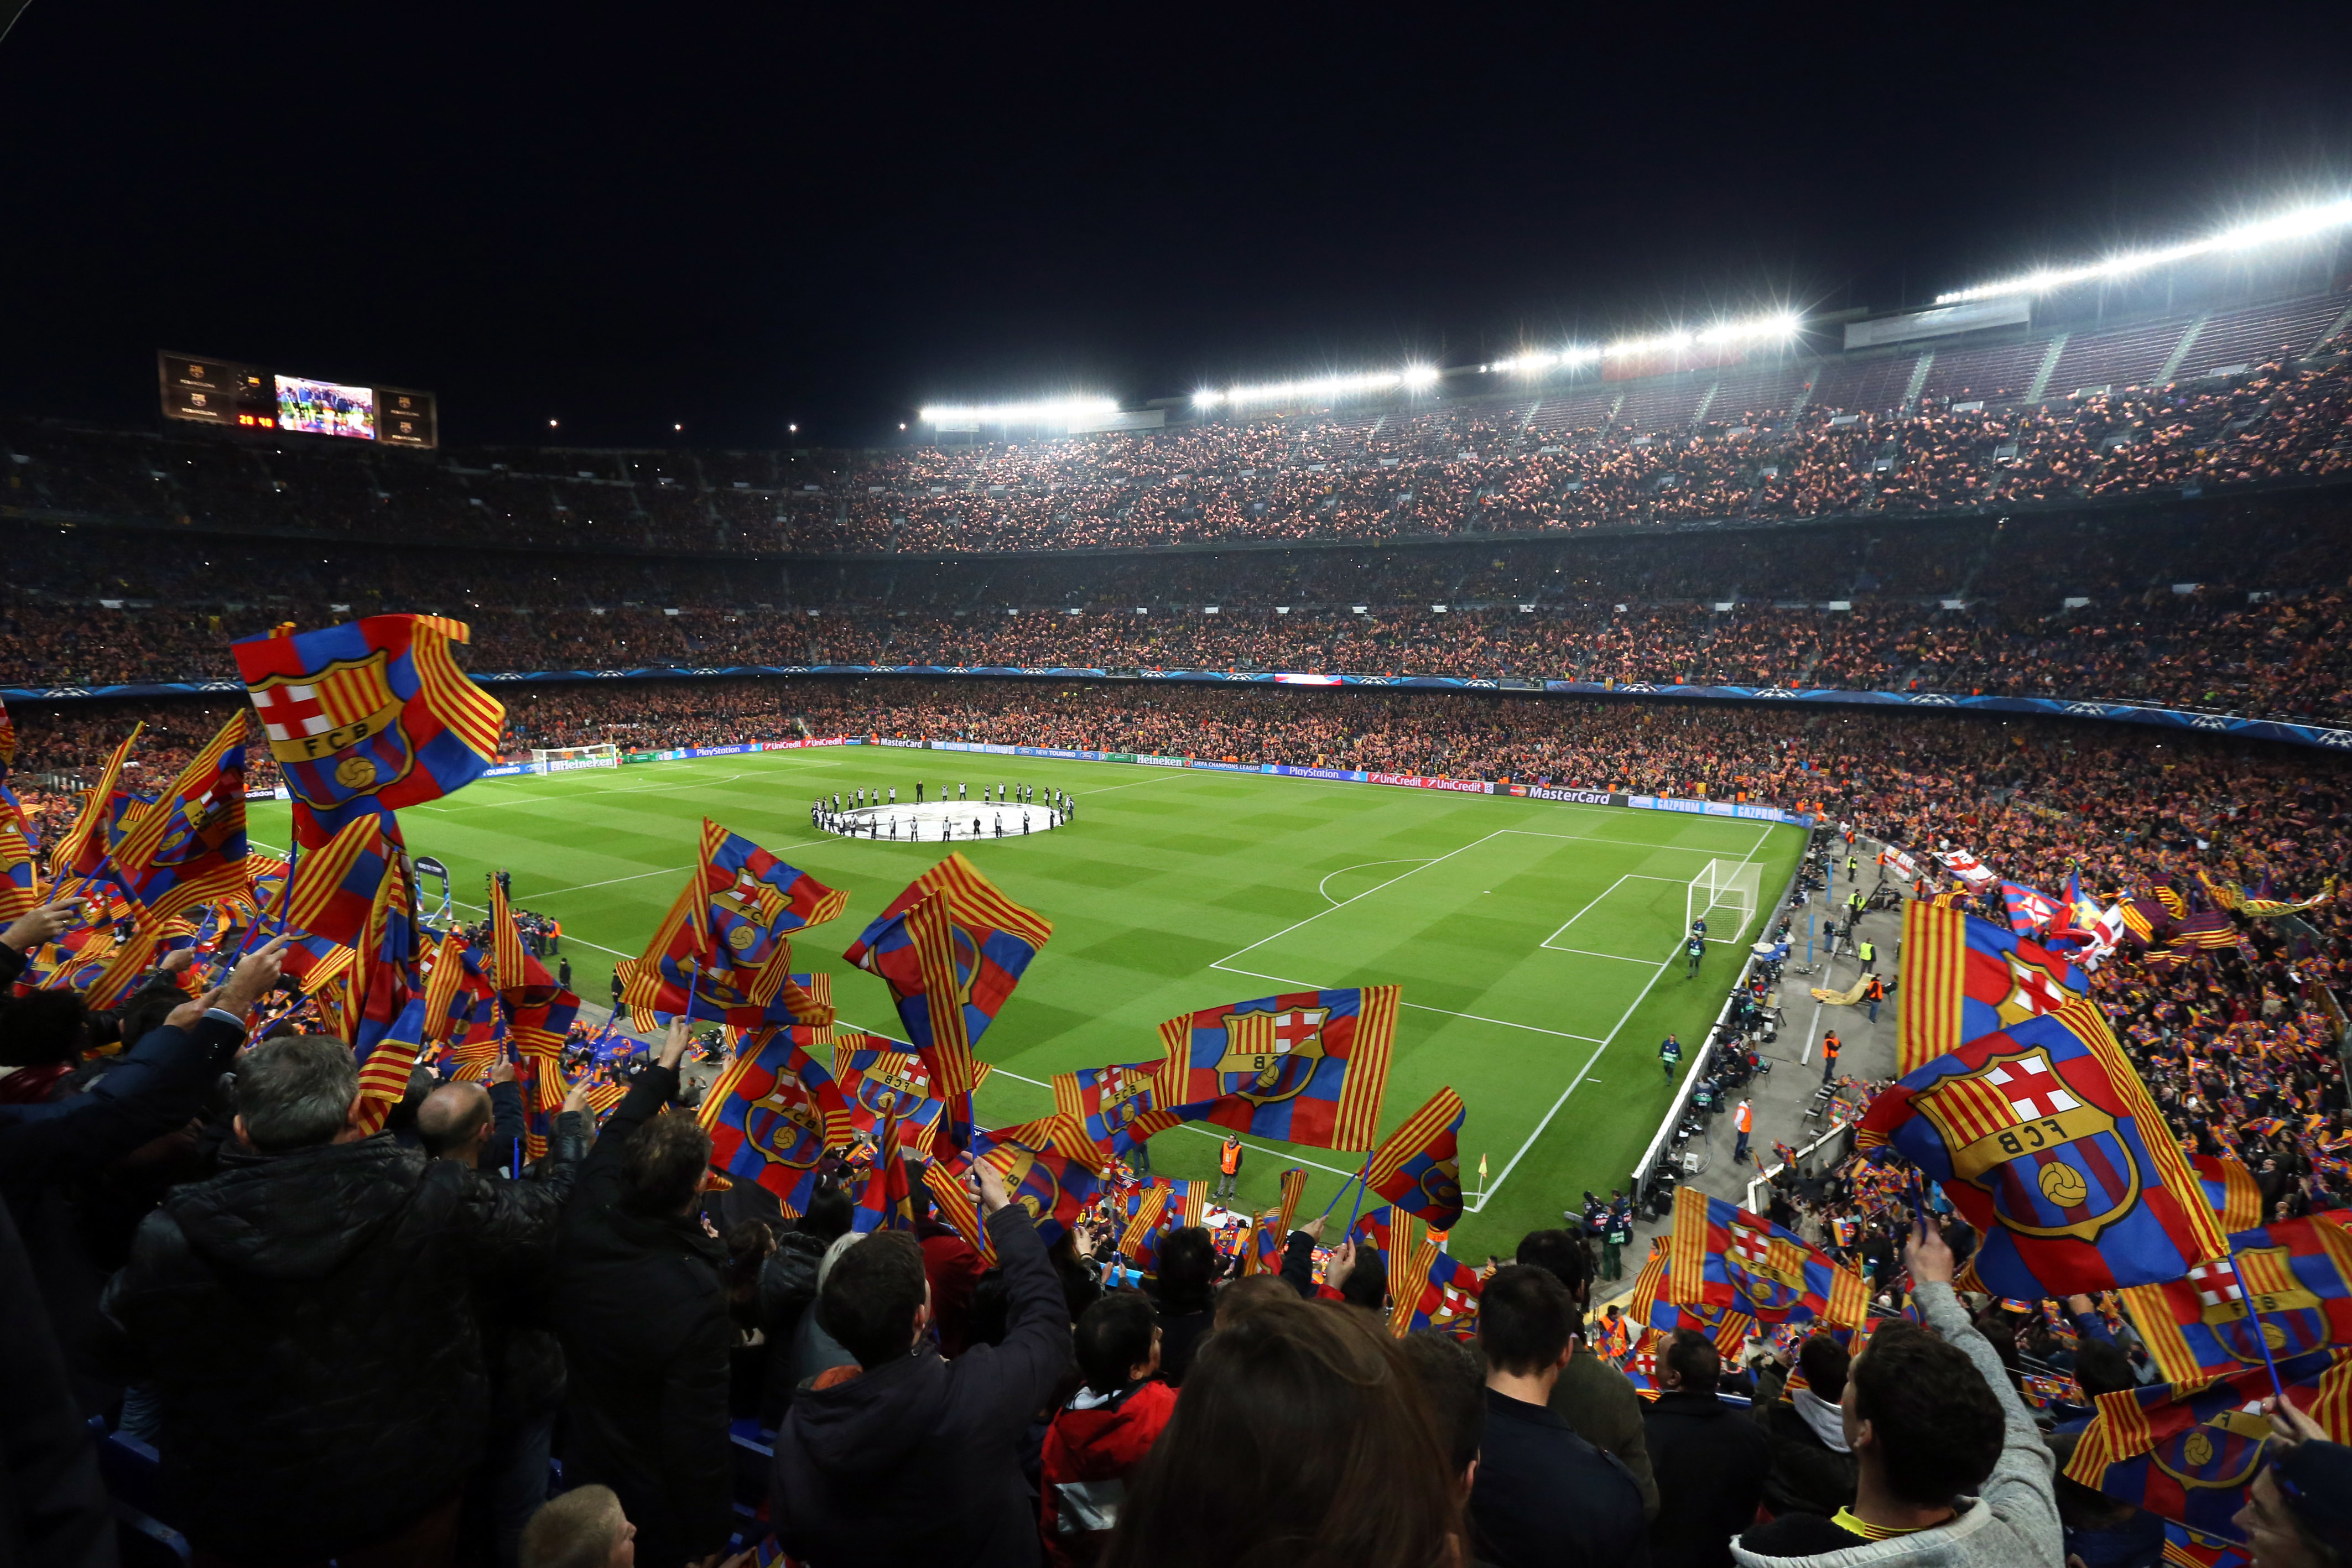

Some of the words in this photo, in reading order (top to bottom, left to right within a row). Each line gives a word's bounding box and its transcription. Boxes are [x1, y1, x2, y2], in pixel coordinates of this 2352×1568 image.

[239, 415, 254, 425] 20
[258, 417, 273, 428] 40
[303, 723, 369, 757] FCB
[772, 741, 801, 750] UniCredit
[811, 738, 842, 746] UniCredit
[881, 739, 923, 748] MasterCard
[697, 747, 740, 757] PlayStation
[946, 743, 967, 751] GAZPROM
[986, 745, 1008, 754] GAZPROM
[559, 758, 613, 770] Heineken
[1137, 754, 1182, 767] Heineken
[483, 767, 521, 775] OURNEO
[1289, 767, 1340, 779] PlayStation
[1380, 774, 1422, 786] UniCredit
[1437, 779, 1481, 792] UniCredit
[1529, 787, 1611, 805] MasterCard
[1657, 799, 1700, 812] GAZPROM
[1738, 806, 1782, 821] GAZPROM
[1113, 1085, 1136, 1104] FCB
[780, 1107, 817, 1129] FCB
[1749, 1262, 1779, 1280] FCB
